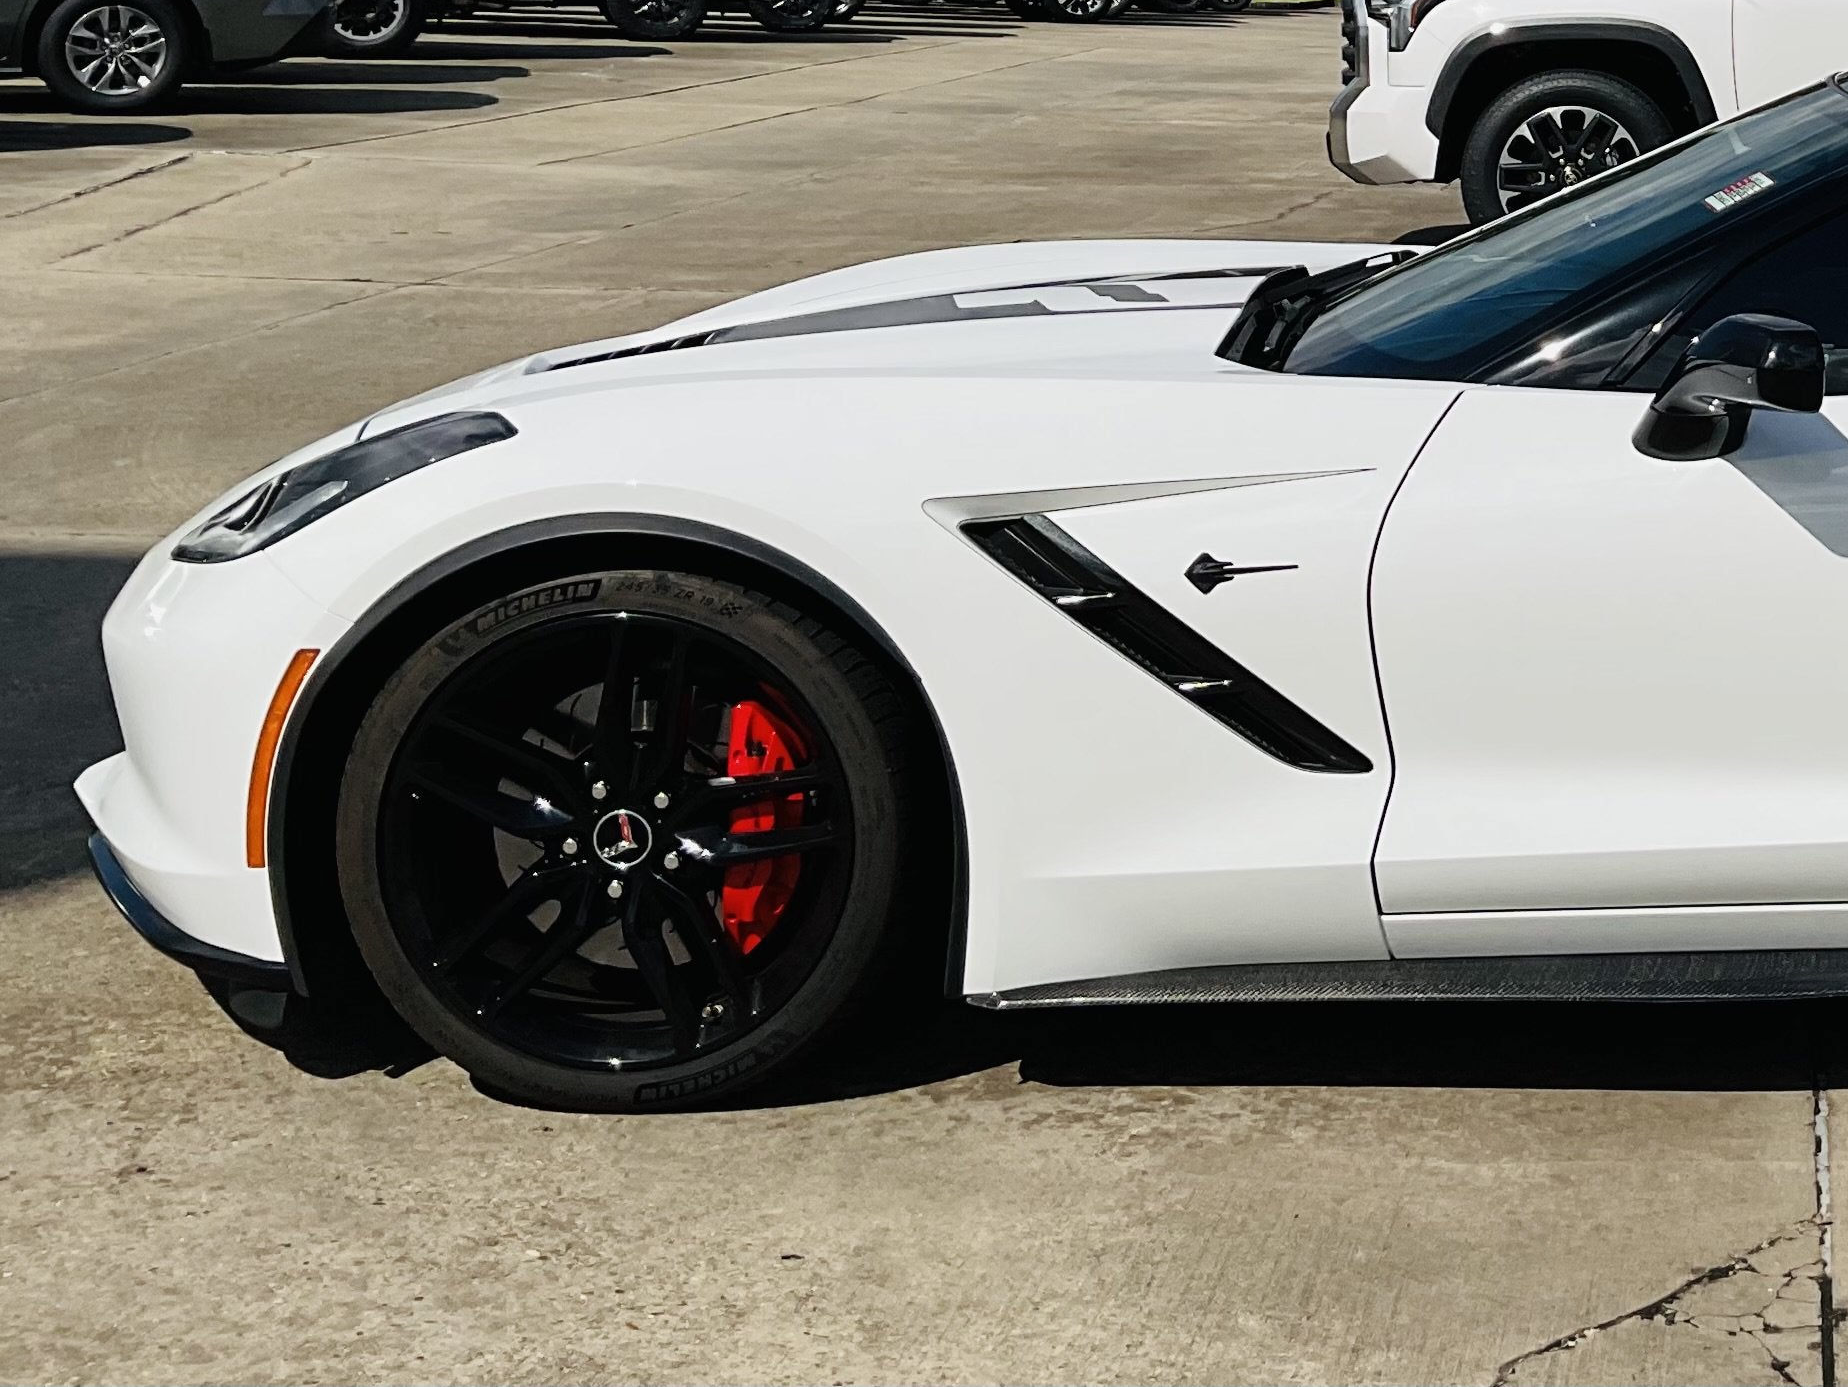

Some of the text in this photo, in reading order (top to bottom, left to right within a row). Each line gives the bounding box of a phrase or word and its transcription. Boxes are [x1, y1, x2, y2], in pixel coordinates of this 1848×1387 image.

[476, 581, 596, 632] MICHELIN
[674, 588, 695, 600] ZR
[699, 595, 715, 606] 19
[639, 1053, 757, 1104] MICHELIN
